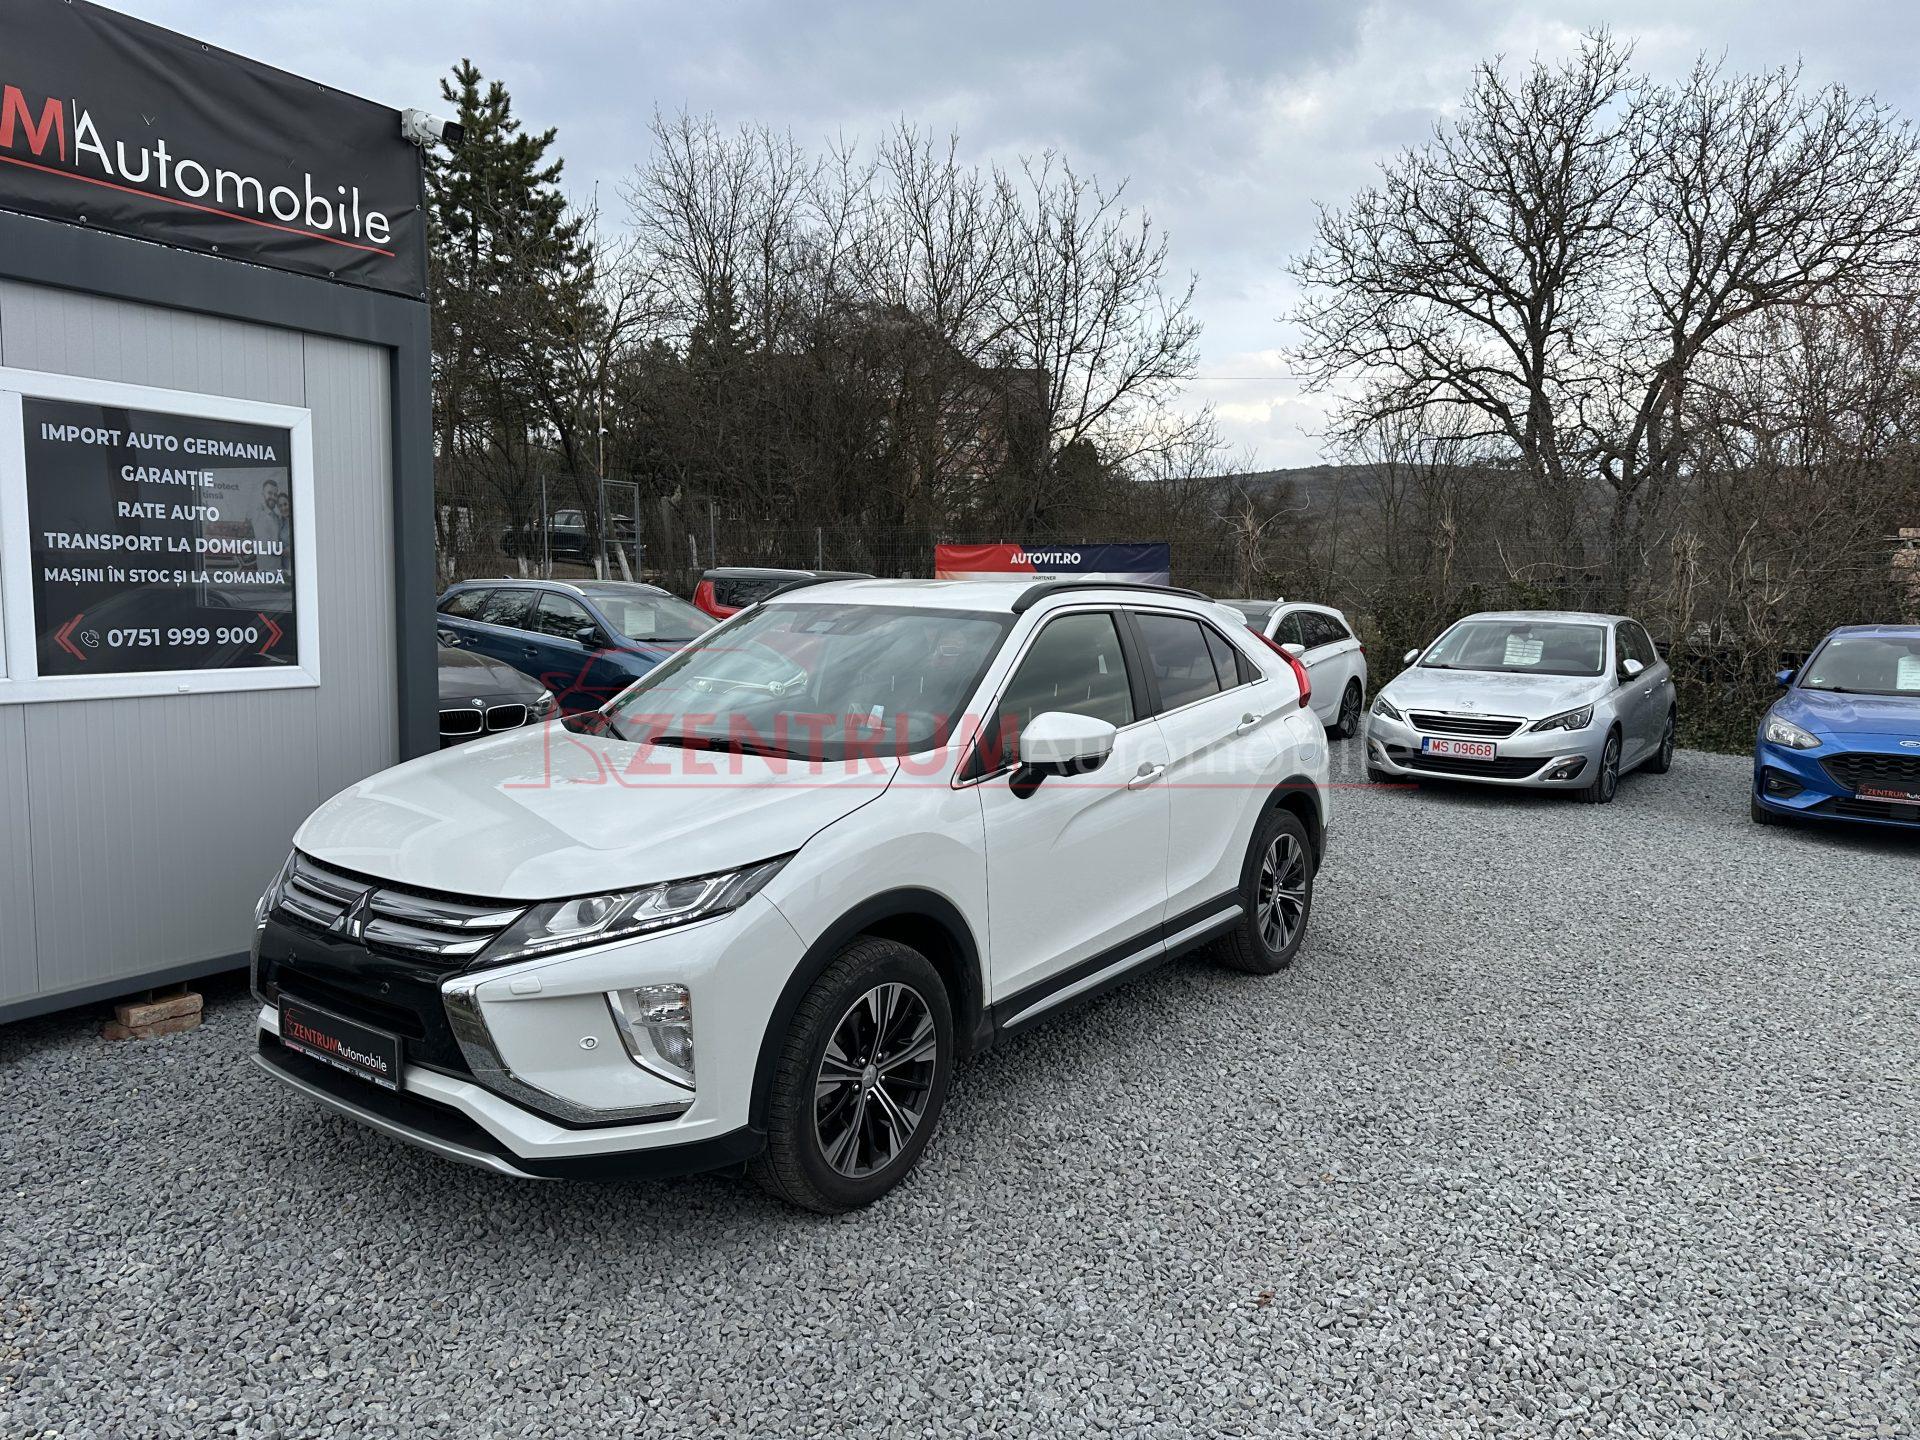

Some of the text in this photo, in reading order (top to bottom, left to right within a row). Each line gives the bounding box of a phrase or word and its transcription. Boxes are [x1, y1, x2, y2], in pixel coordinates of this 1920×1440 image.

[76, 109, 391, 244] Automobile
[41, 422, 276, 461] IMPORT AUTO GERMANIA
[121, 465, 215, 491] GARANȚIE
[117, 501, 220, 521] RATE AUTO
[44, 532, 284, 556] TRANSPORT LA DOMICILIU
[1010, 552, 1081, 564] AUTOVIT.RO
[44, 565, 285, 587] MAȘINI ÎN STOC ȘI LA COMANDĂ
[107, 626, 259, 647] 0751 999 900
[1432, 740, 1449, 753] MS
[1454, 742, 1492, 756] 09668
[293, 1022, 338, 1052] ZENTRUM
[338, 1041, 387, 1072] Automobile
